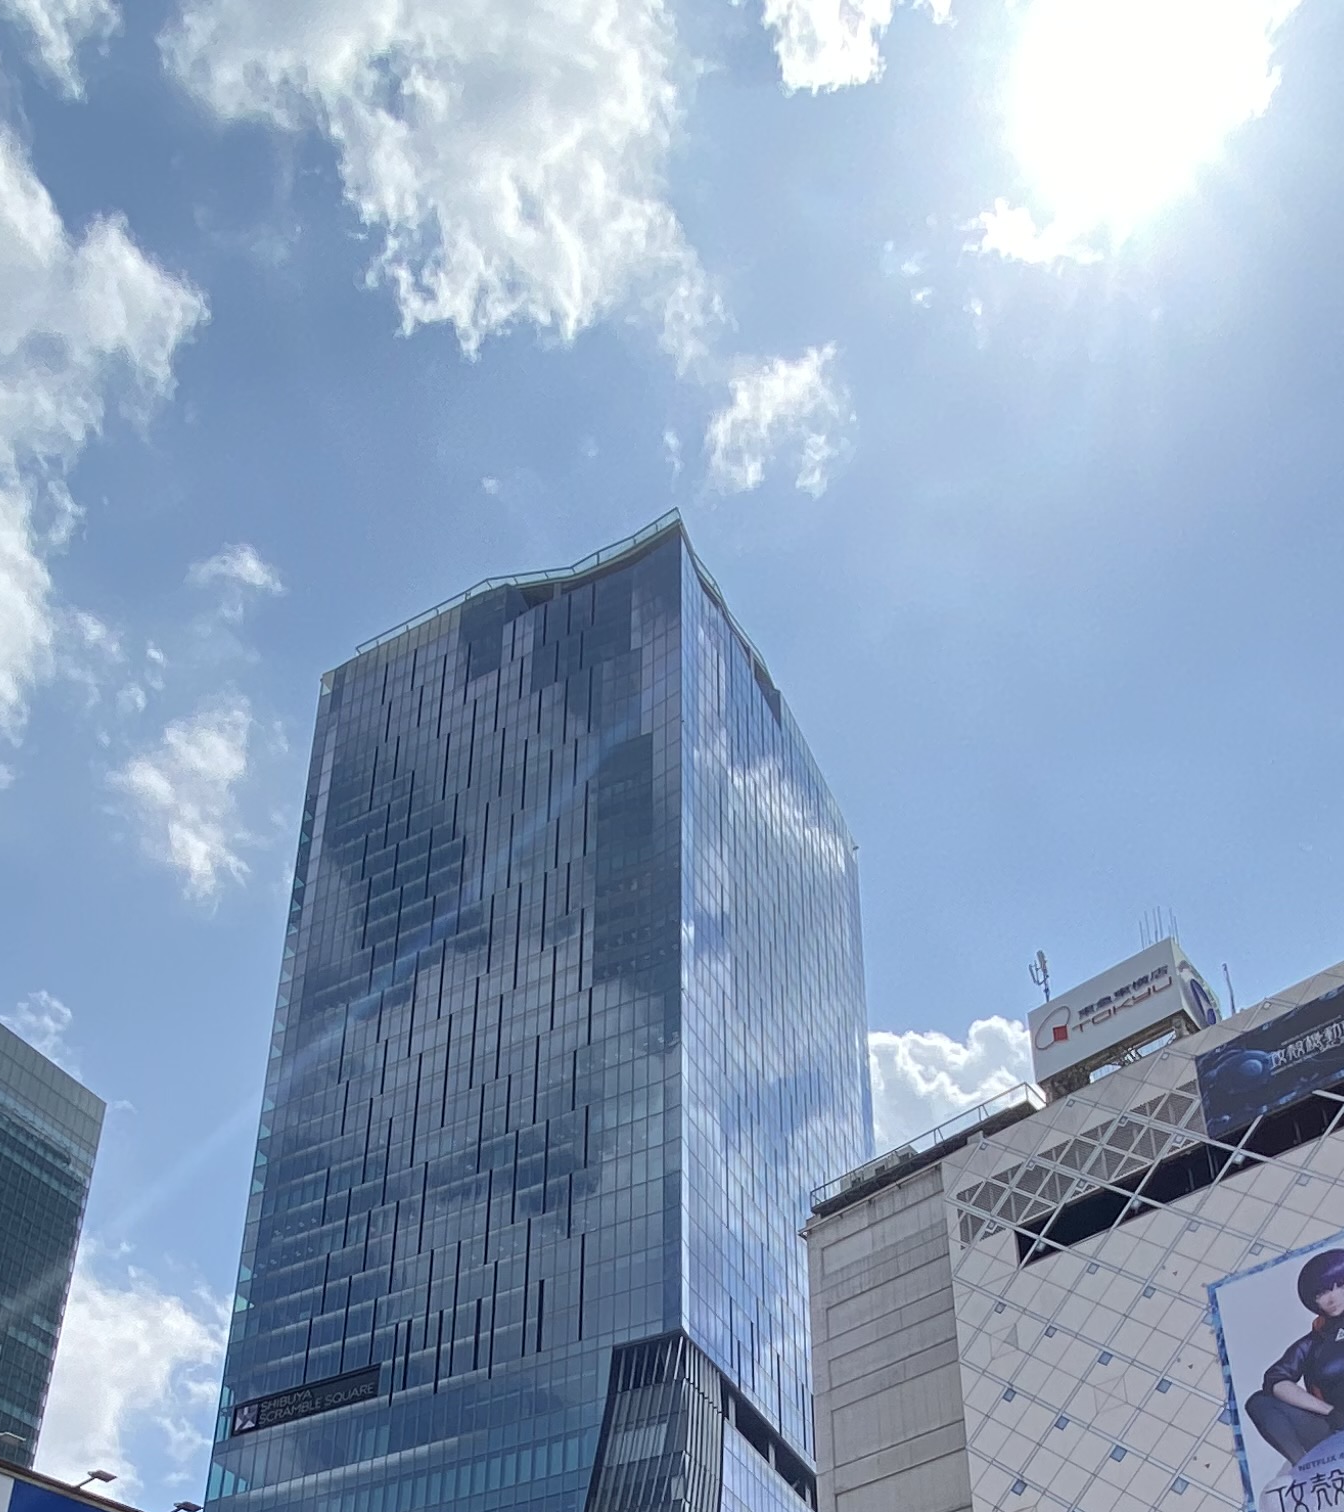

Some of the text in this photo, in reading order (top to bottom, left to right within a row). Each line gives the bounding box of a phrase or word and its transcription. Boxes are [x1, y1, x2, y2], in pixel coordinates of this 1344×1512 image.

[1072, 976, 1172, 1033] TOKYU
[258, 1383, 375, 1425] SCRAMBLE SQUARE
[260, 1389, 313, 1412] SHIBUYA
